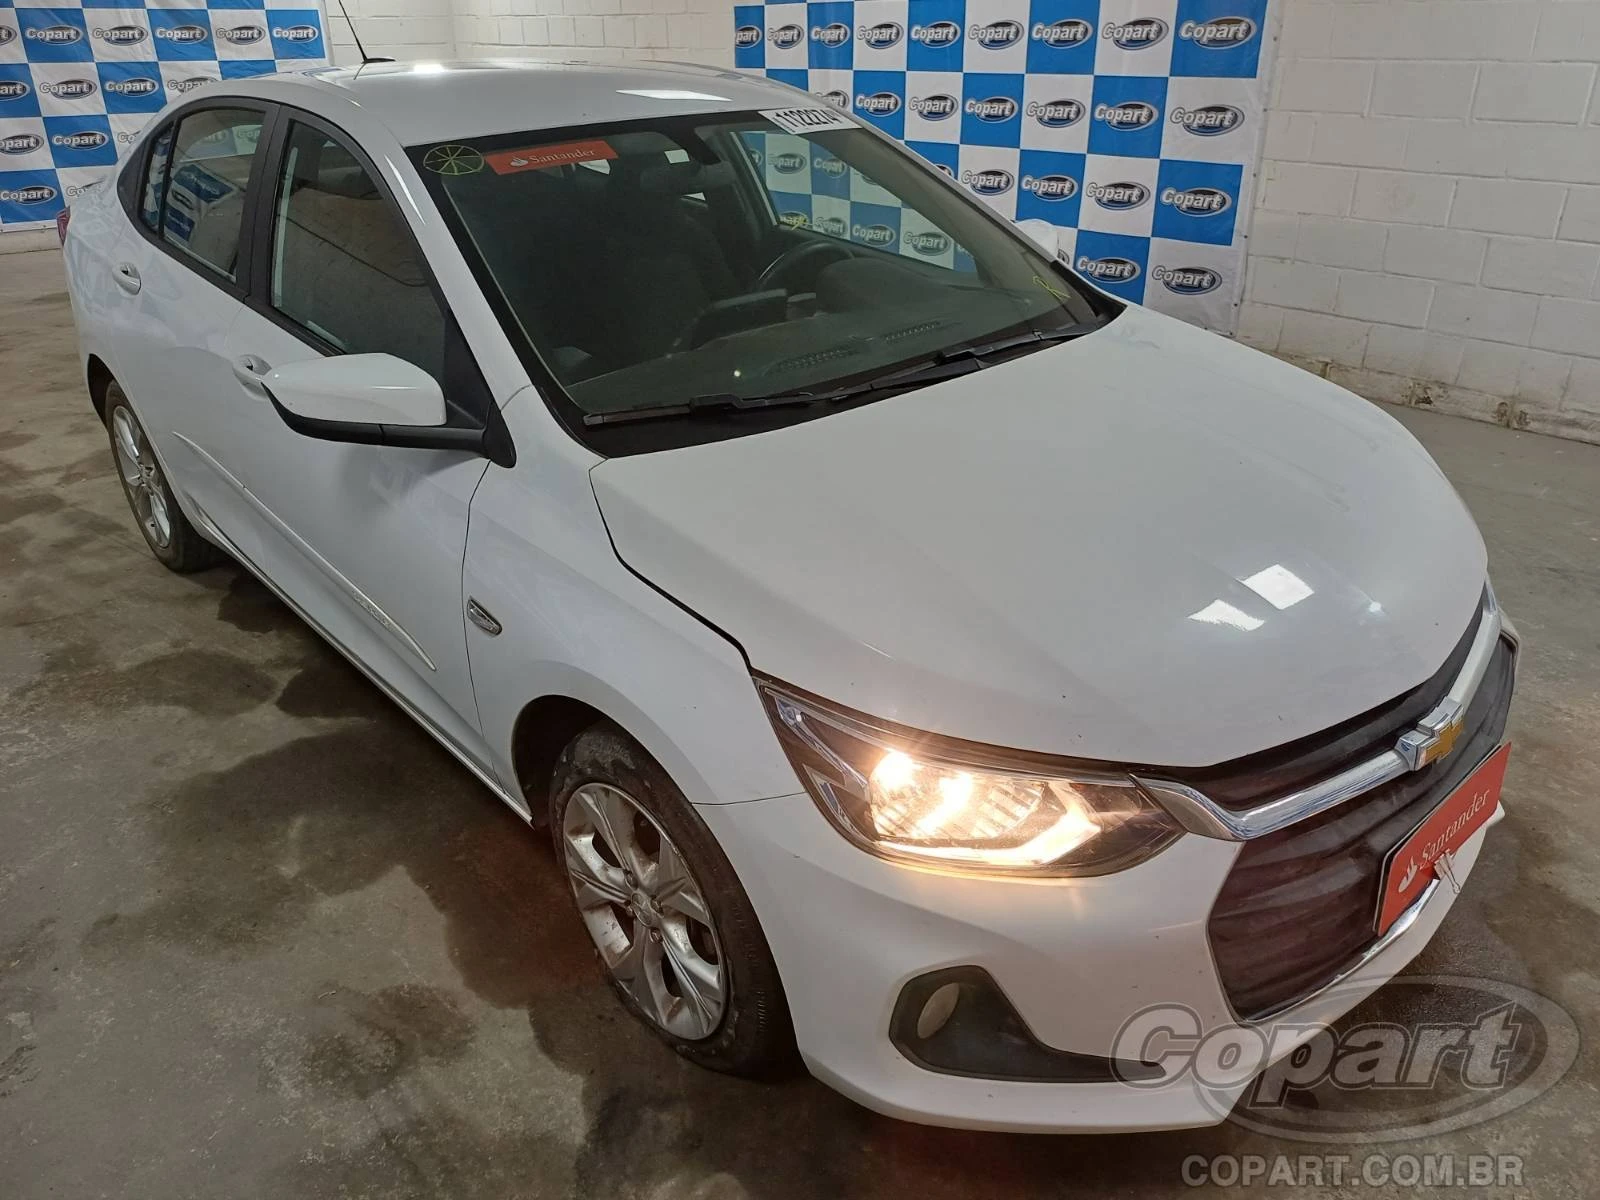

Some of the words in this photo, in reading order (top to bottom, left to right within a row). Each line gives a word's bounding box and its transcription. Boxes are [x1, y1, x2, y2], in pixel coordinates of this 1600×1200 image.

[25, 27, 76, 42] Copart
[92, 27, 140, 41] Copart
[155, 28, 202, 41] Copart
[216, 28, 260, 41] Copart
[272, 27, 314, 40] Copart
[767, 28, 799, 43] Copart
[811, 27, 844, 43] Copart
[856, 25, 897, 42] Copart
[911, 25, 954, 42] Copart
[968, 23, 1017, 43] Copart
[1032, 23, 1085, 42] Copart
[1101, 22, 1158, 42] Copart
[1180, 20, 1248, 41] Copart
[40, 82, 89, 95] Copart
[105, 81, 153, 95] Copart
[855, 94, 896, 113] Copart
[908, 96, 952, 115] Copart
[965, 98, 1012, 118] Copart
[1027, 101, 1078, 122] Copart
[1094, 104, 1151, 125] Copart
[1170, 106, 1233, 129] Copart
[0, 136, 36, 151] opart
[52, 135, 101, 148] Copart
[529, 148, 596, 164] Santander
[962, 170, 1008, 190] Copart
[1022, 176, 1072, 197] Copart
[0, 188, 50, 201] Copart
[1086, 183, 1139, 205] Copart
[1161, 188, 1222, 210] Copart
[1077, 257, 1133, 279] Copart
[1152, 265, 1214, 289] Copart
[1420, 789, 1490, 870] Santander
